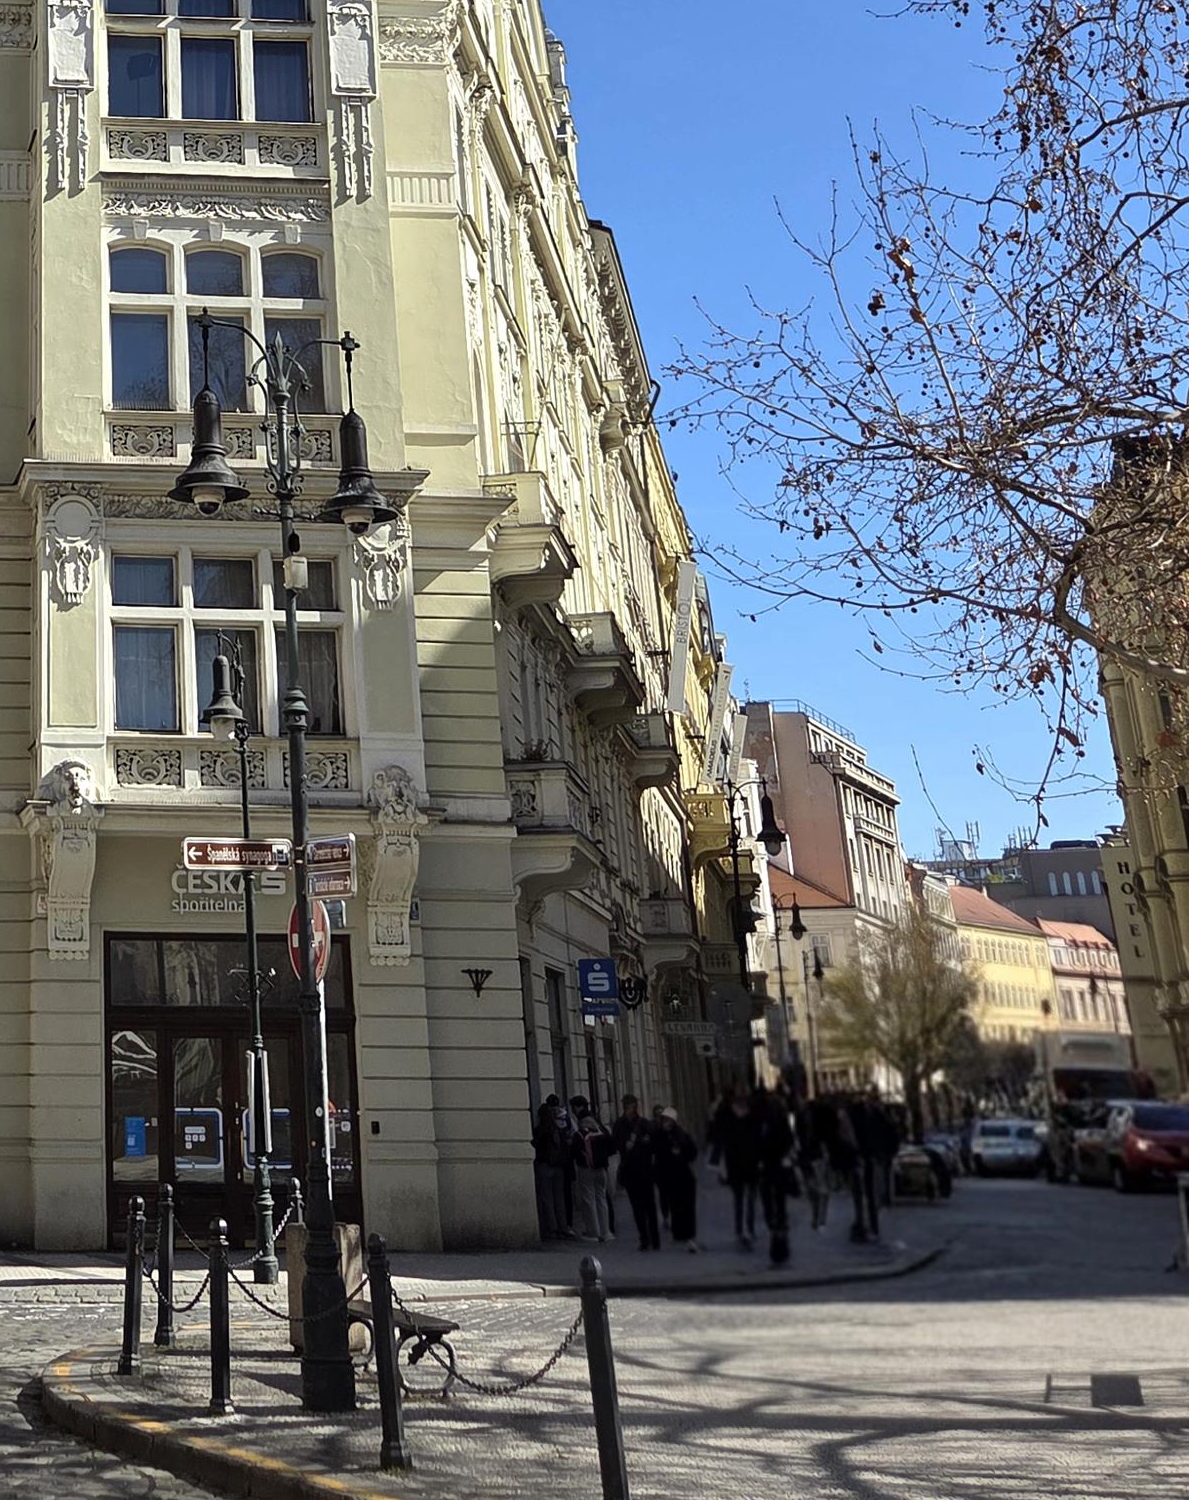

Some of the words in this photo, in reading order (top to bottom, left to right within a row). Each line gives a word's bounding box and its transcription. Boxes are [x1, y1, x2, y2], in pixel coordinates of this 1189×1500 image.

[676, 596, 690, 644] BRISTOL
[207, 844, 240, 864] Španělská
[241, 849, 272, 865] synagoga
[171, 896, 246, 914] spořitelna
[1117, 861, 1145, 959] HOTEL
